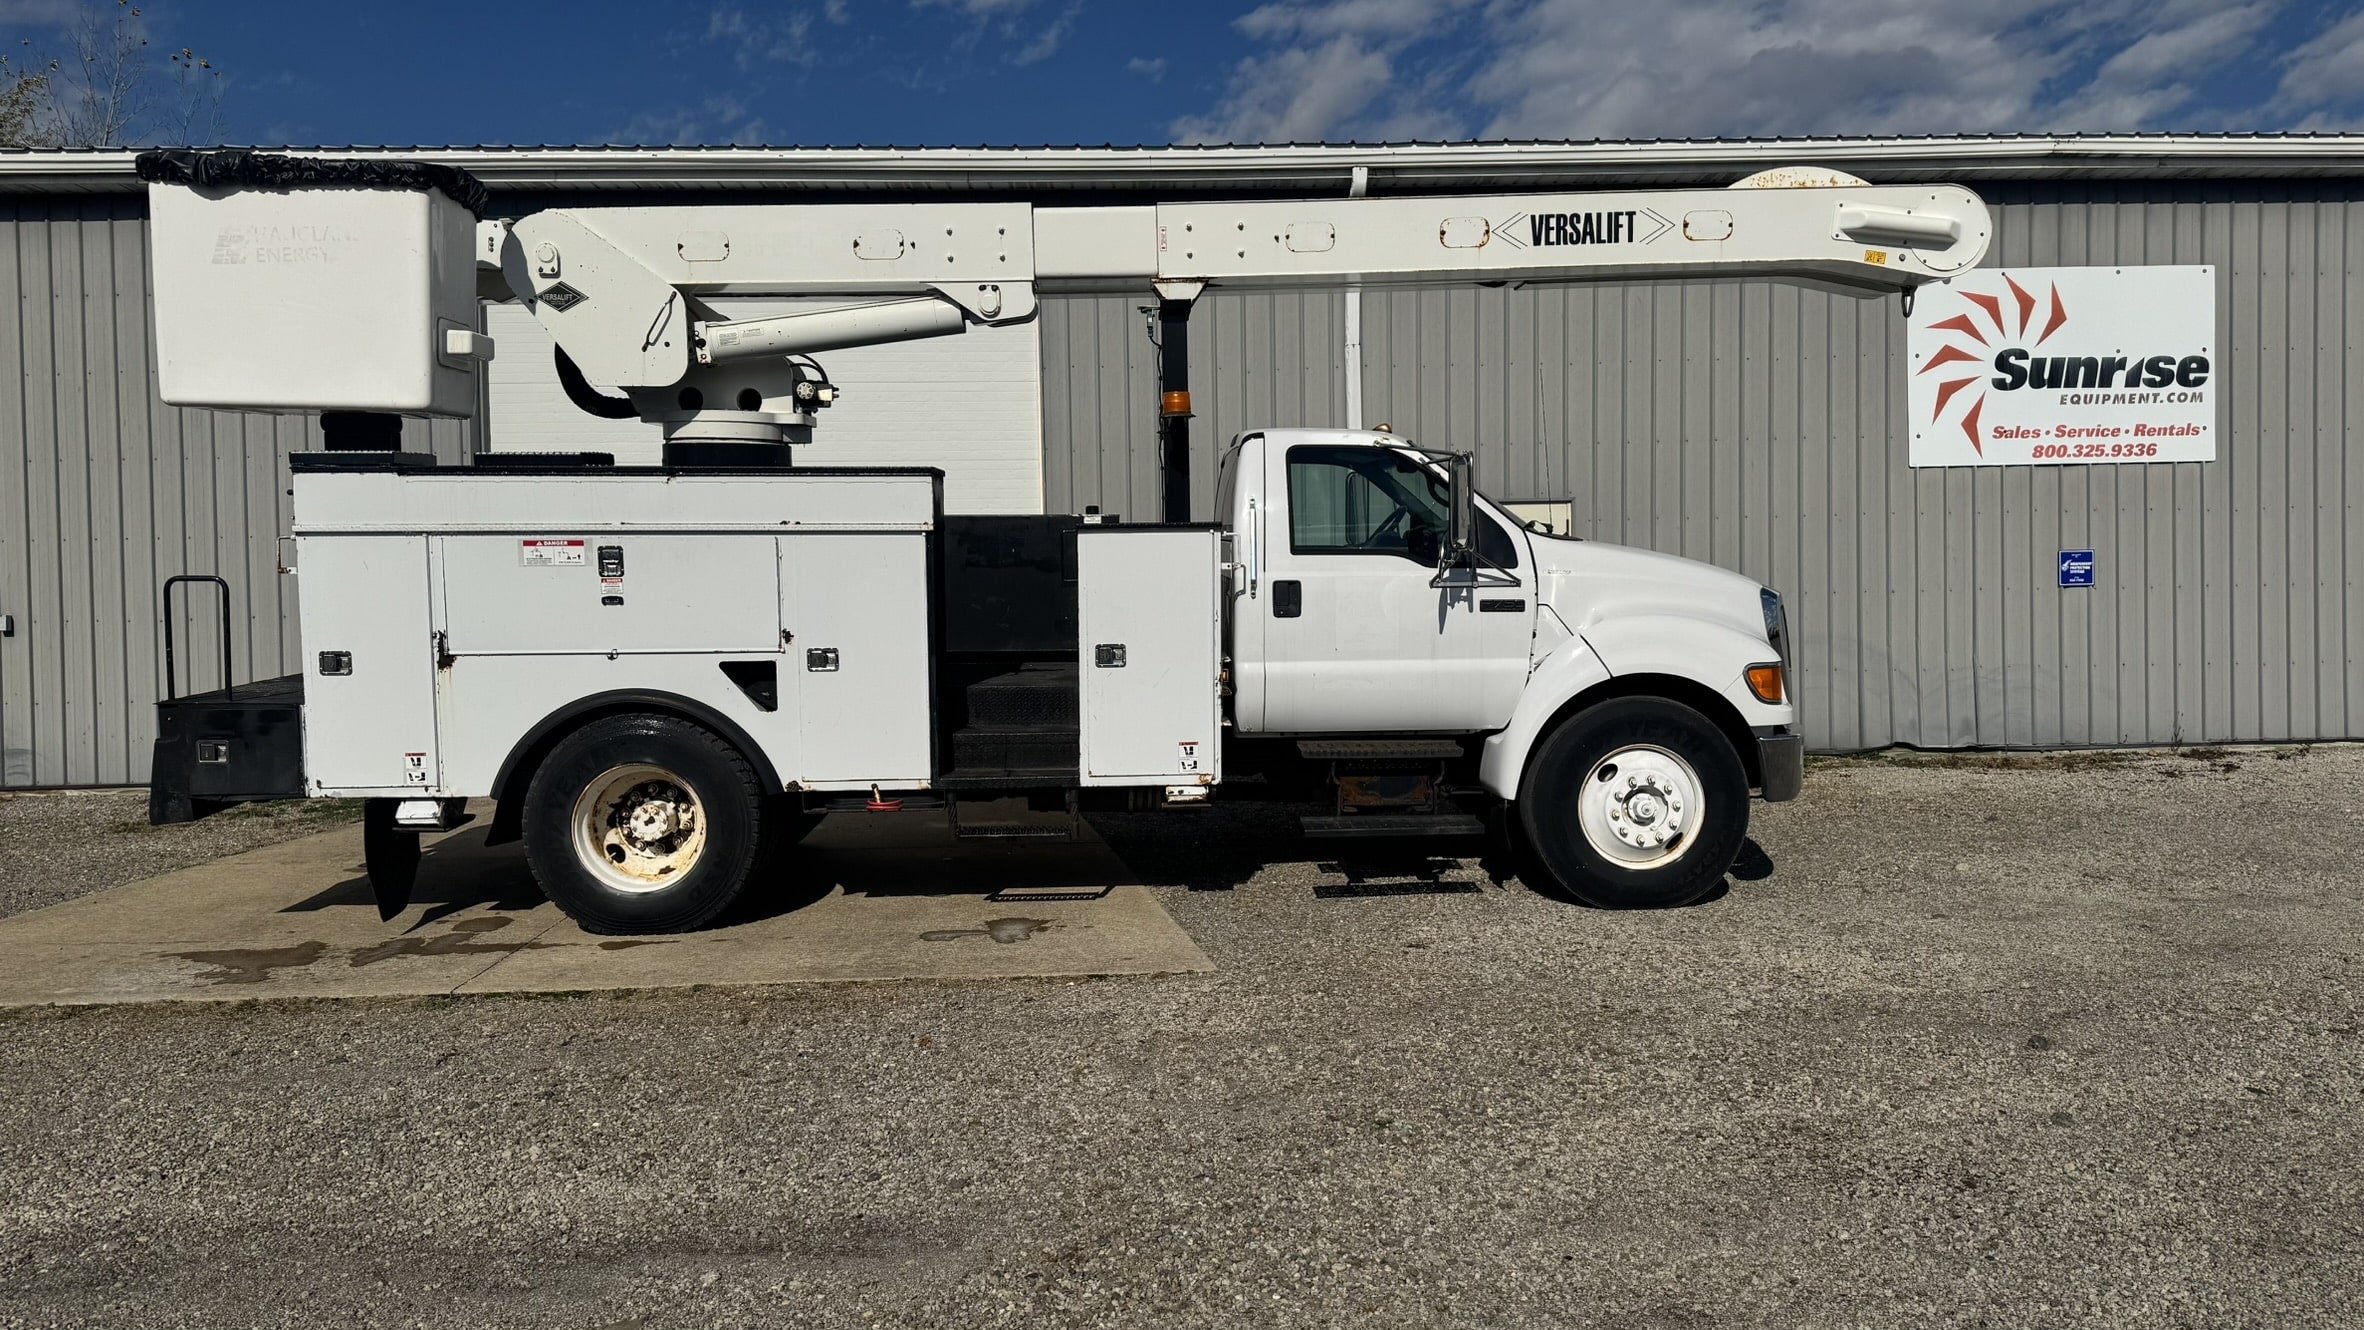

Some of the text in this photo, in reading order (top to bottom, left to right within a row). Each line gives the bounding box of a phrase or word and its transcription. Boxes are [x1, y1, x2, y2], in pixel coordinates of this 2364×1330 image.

[1530, 211, 1637, 246] VERSALIFT
[256, 247, 329, 263] ENERGY
[542, 293, 573, 301] VERSALIFT
[1991, 347, 2210, 391] Sunrise
[2059, 392, 2204, 406] EQUIPMENT.COM
[1992, 423, 2200, 440] Sales Service Rentals
[2032, 443, 2158, 459] 800.325.9336
